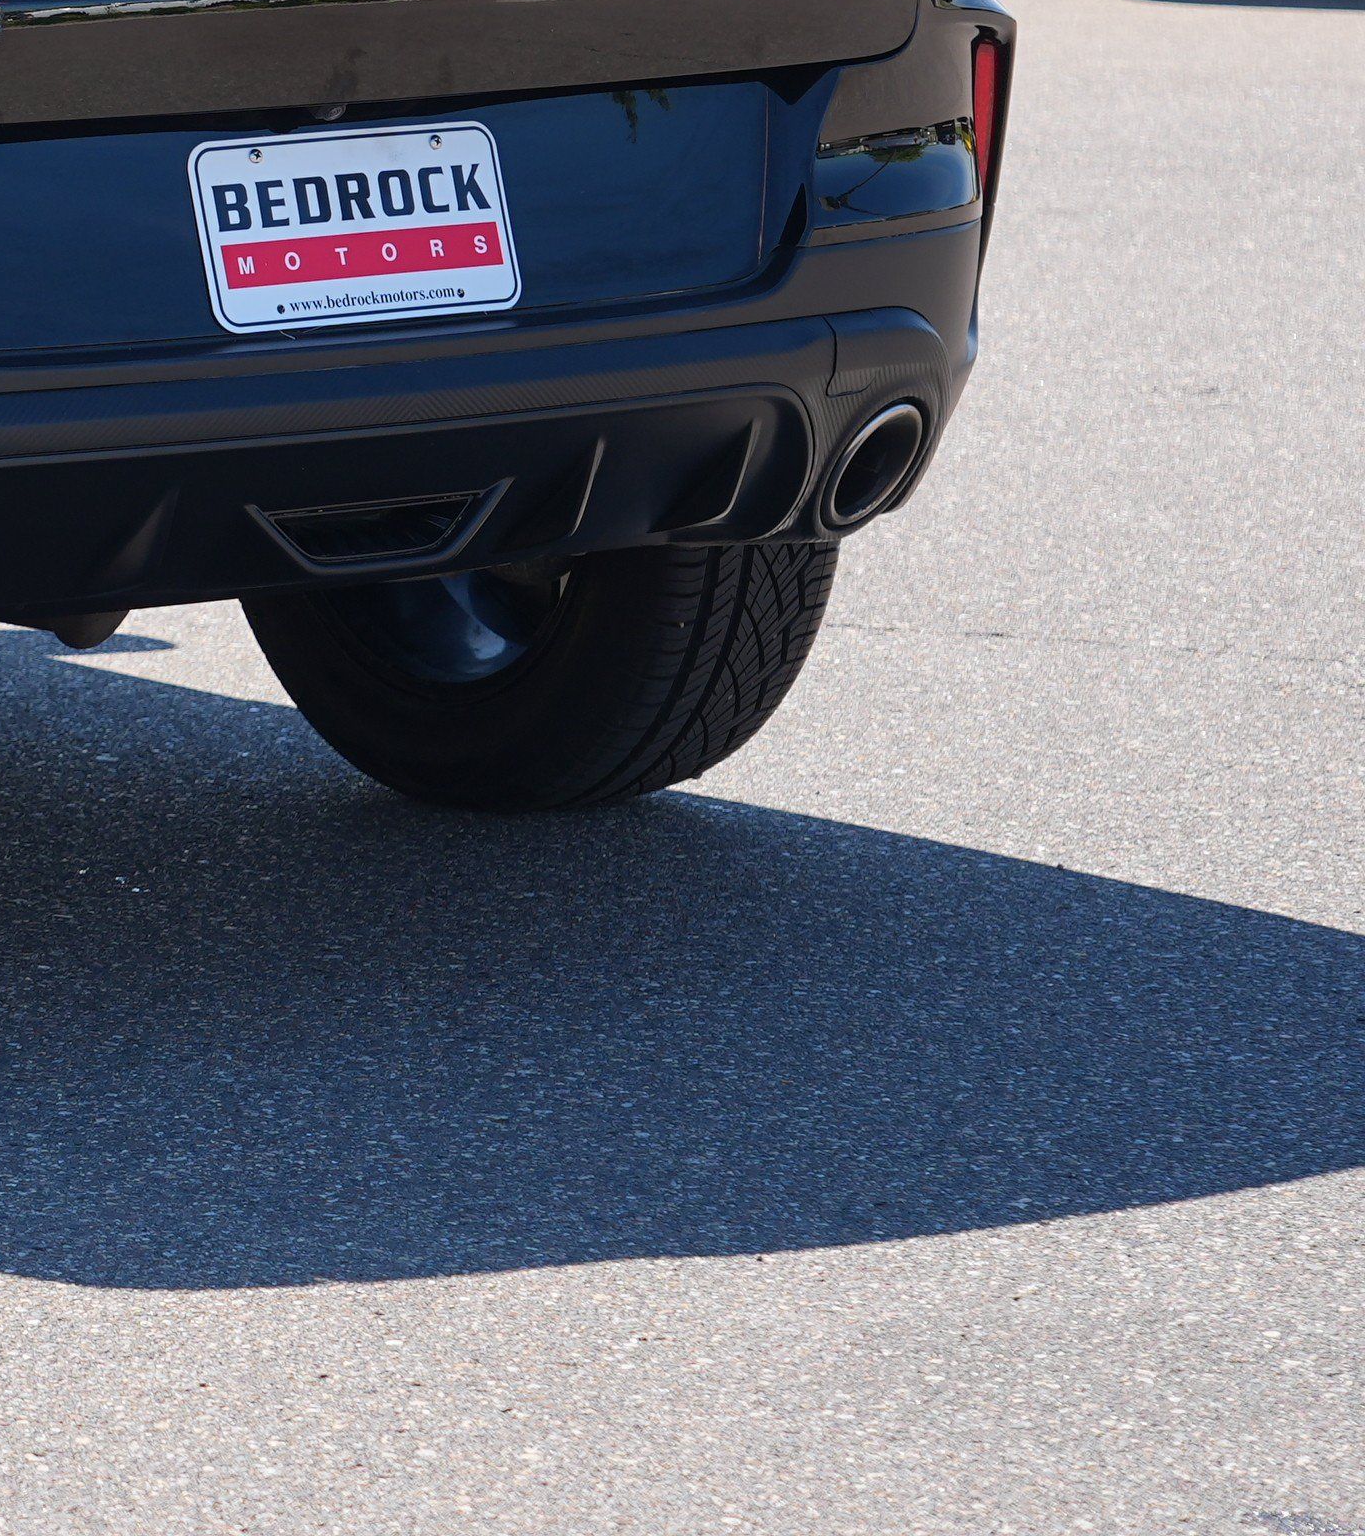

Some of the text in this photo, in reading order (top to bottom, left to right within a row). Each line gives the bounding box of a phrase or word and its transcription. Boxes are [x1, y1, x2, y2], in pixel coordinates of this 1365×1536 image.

[212, 164, 491, 232] BEDROCK
[238, 235, 488, 275] MOTORS
[289, 286, 455, 312] www.bedrockmotors.com
